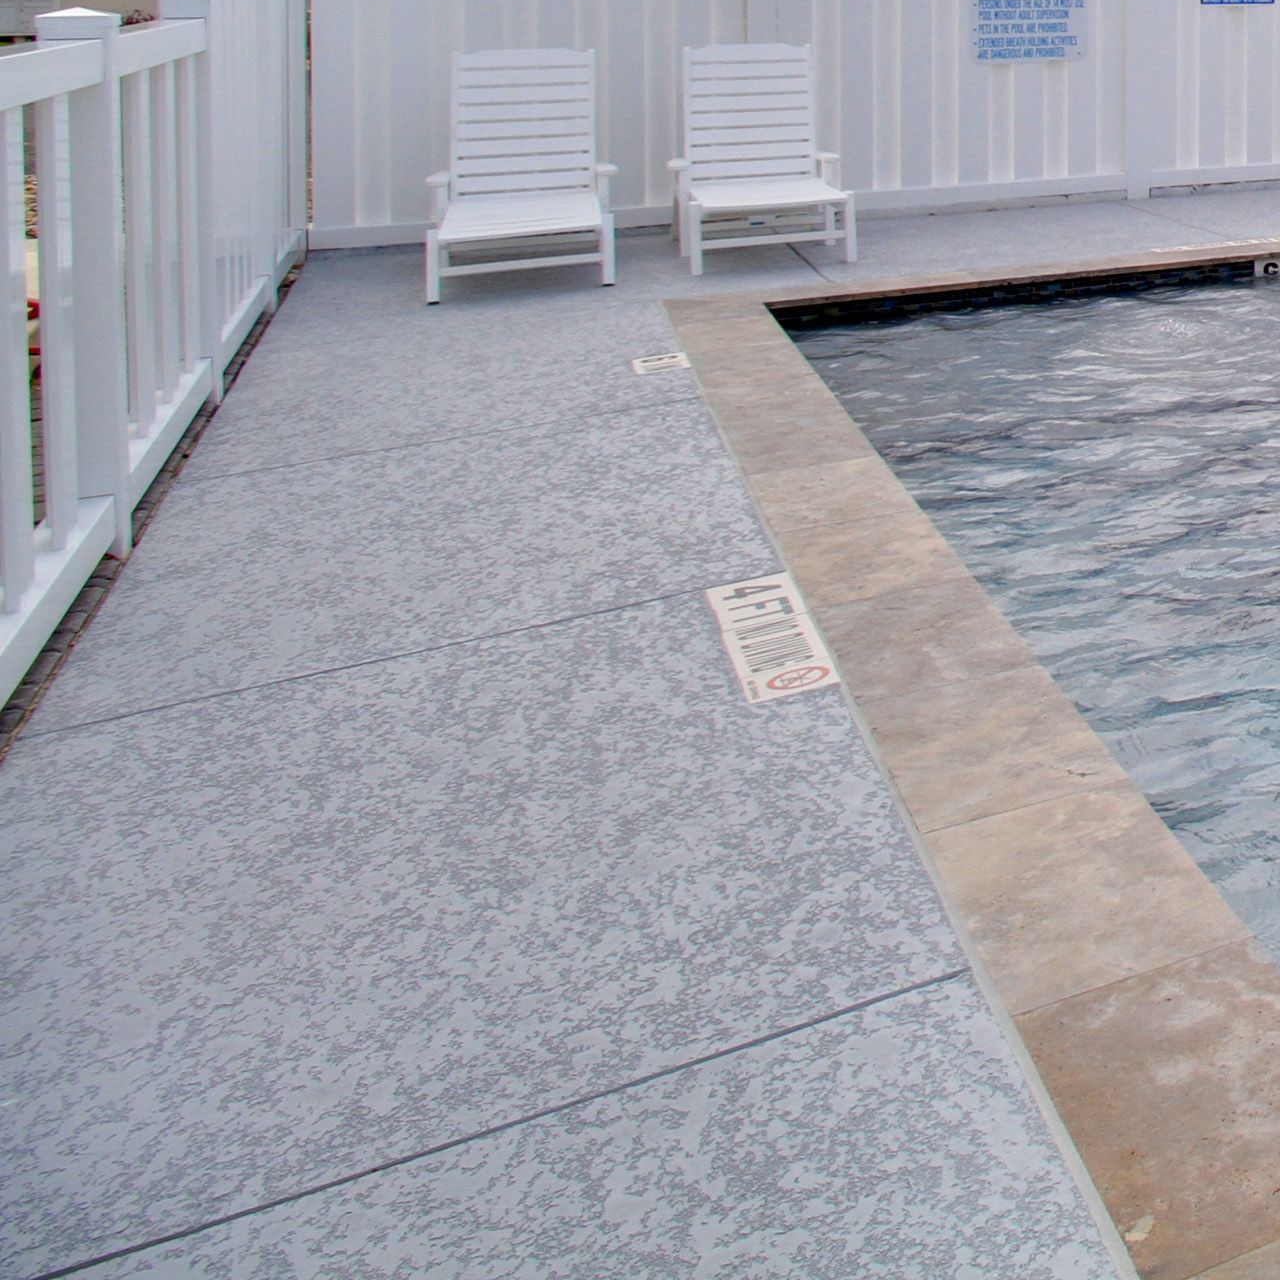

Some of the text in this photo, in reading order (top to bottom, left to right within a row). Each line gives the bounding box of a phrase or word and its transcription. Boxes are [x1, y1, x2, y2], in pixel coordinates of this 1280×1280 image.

[722, 584, 795, 623] 4 FT
[734, 616, 815, 673] NO DIVING
